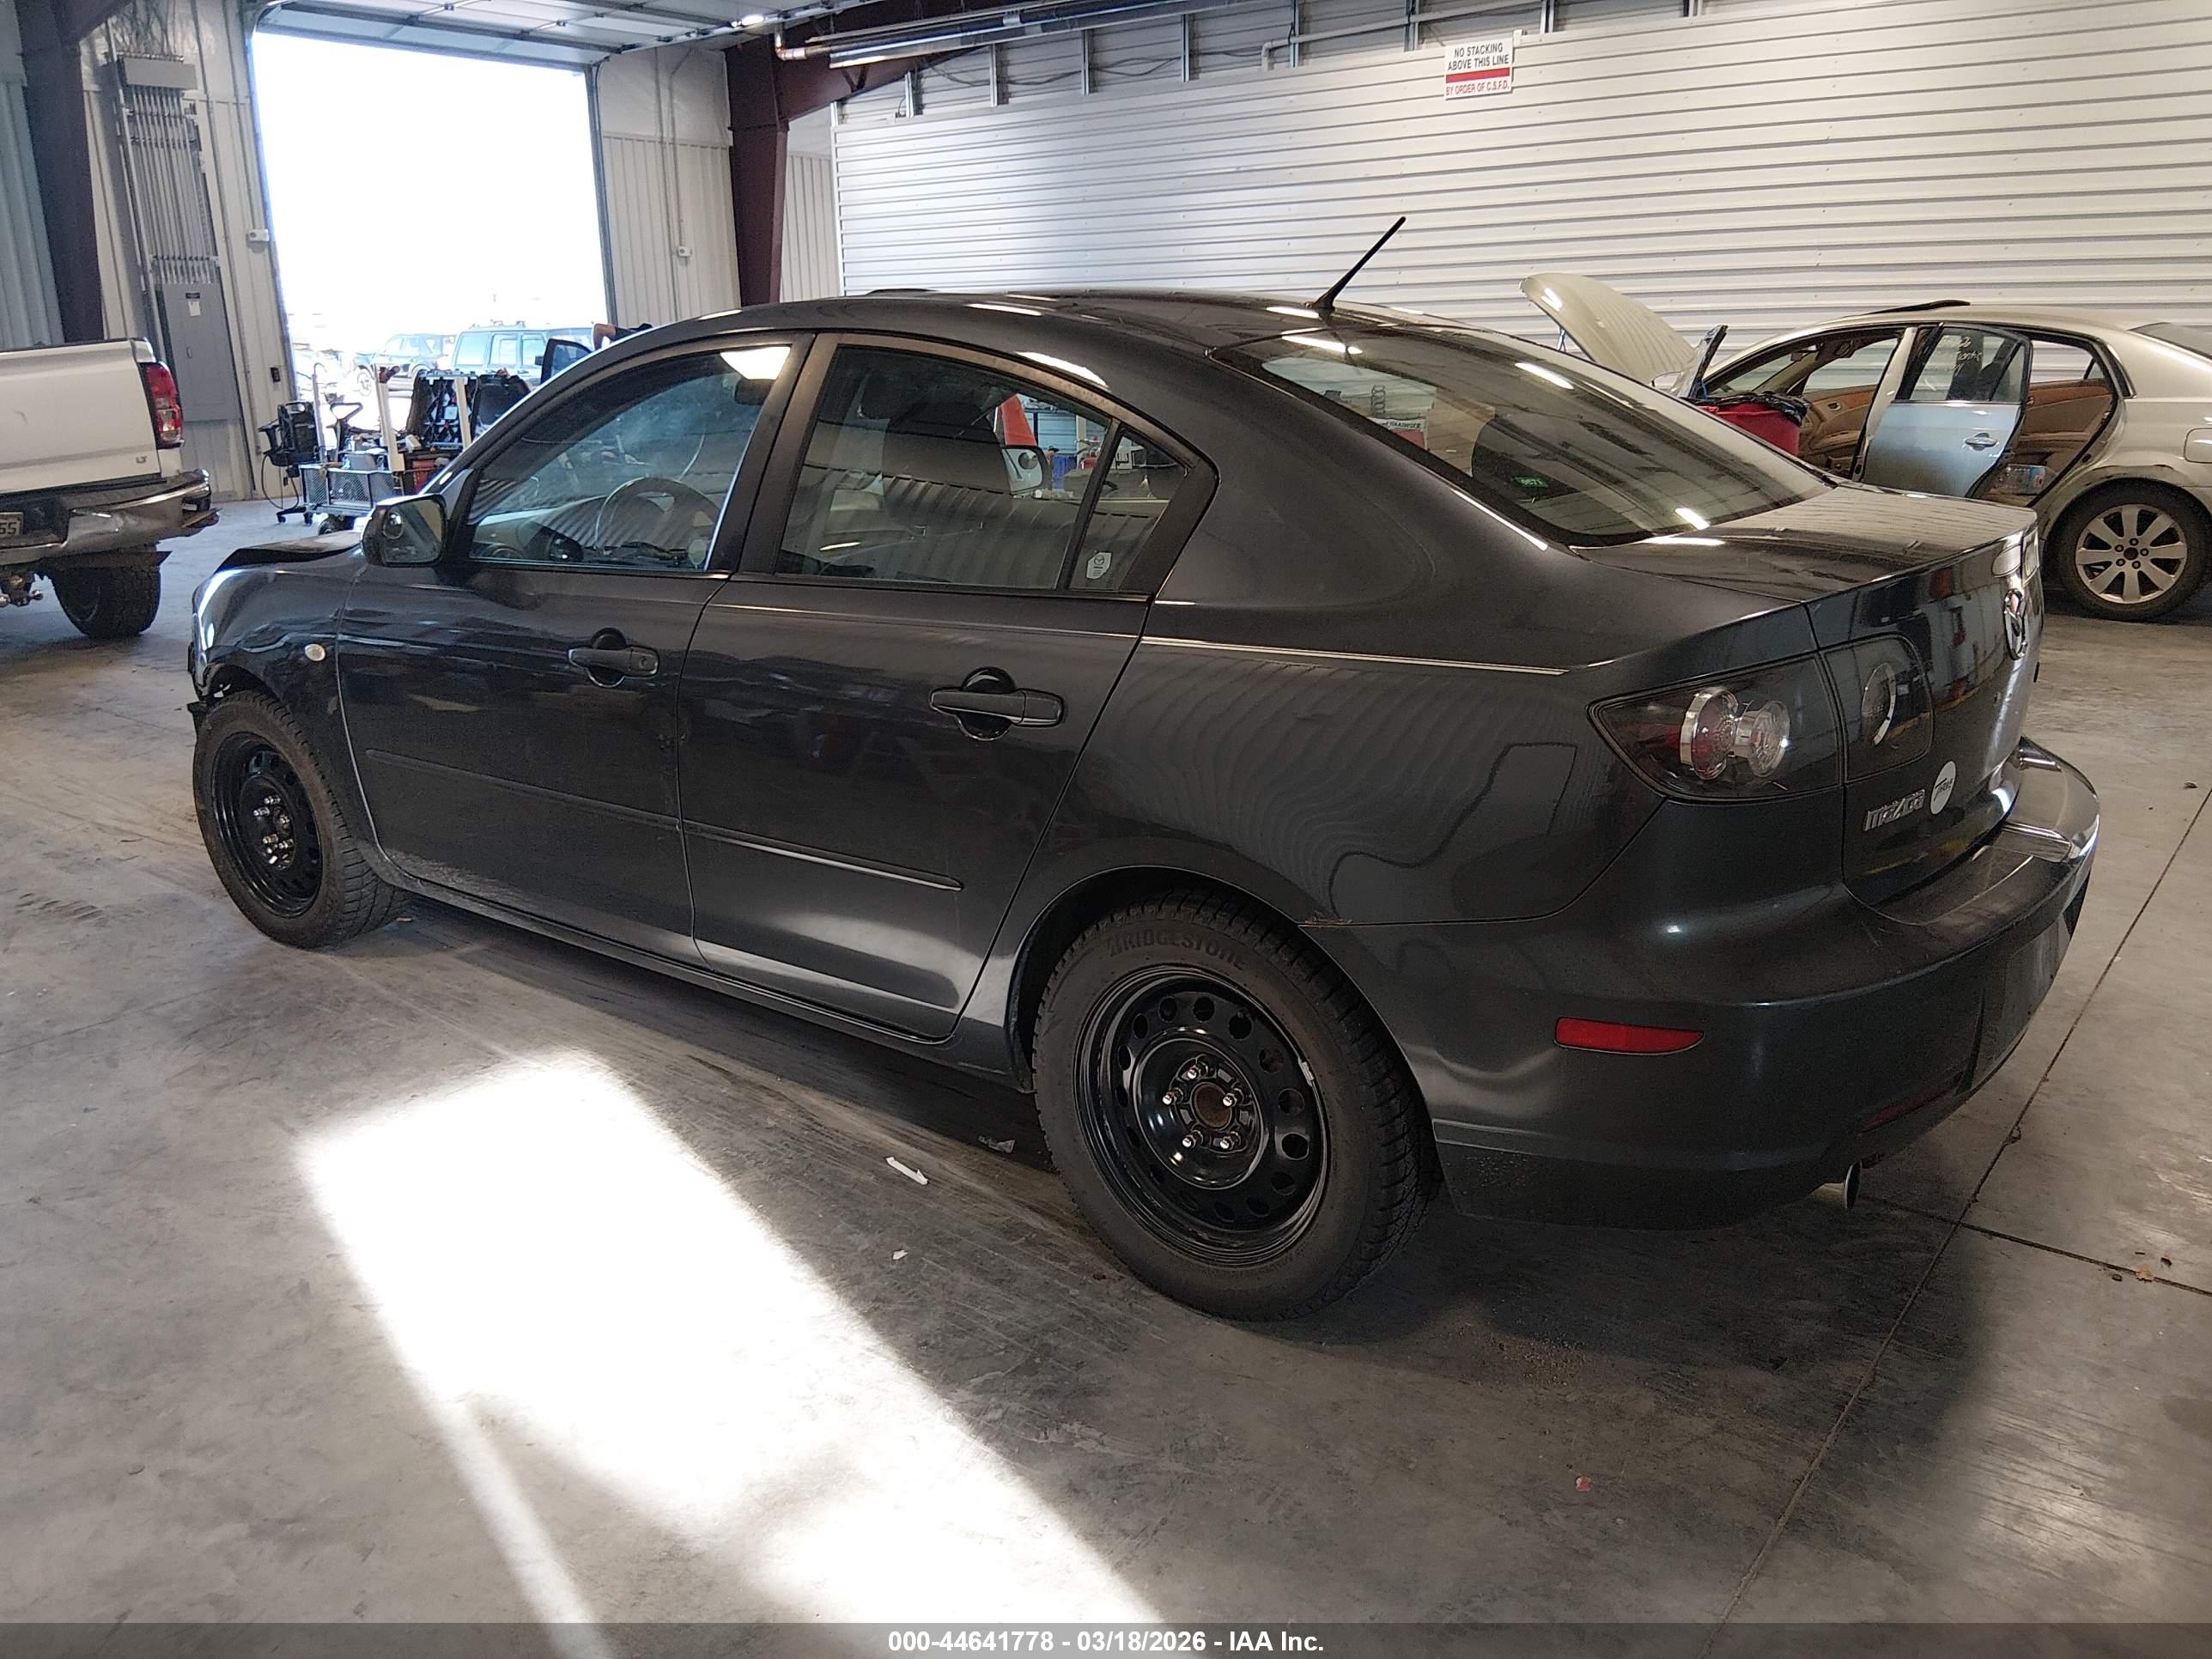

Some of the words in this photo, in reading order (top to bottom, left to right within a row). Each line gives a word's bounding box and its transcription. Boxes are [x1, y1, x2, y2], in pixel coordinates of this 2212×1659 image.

[1454, 47, 1465, 58] NO
[1467, 42, 1504, 56] STACKING
[1448, 58, 1472, 70] ABOVE
[1474, 55, 1490, 68] THIS
[1492, 54, 1510, 65] LINE
[1446, 86, 1454, 96] BY
[1455, 82, 1475, 94] ORDER
[1477, 82, 1485, 92] OF
